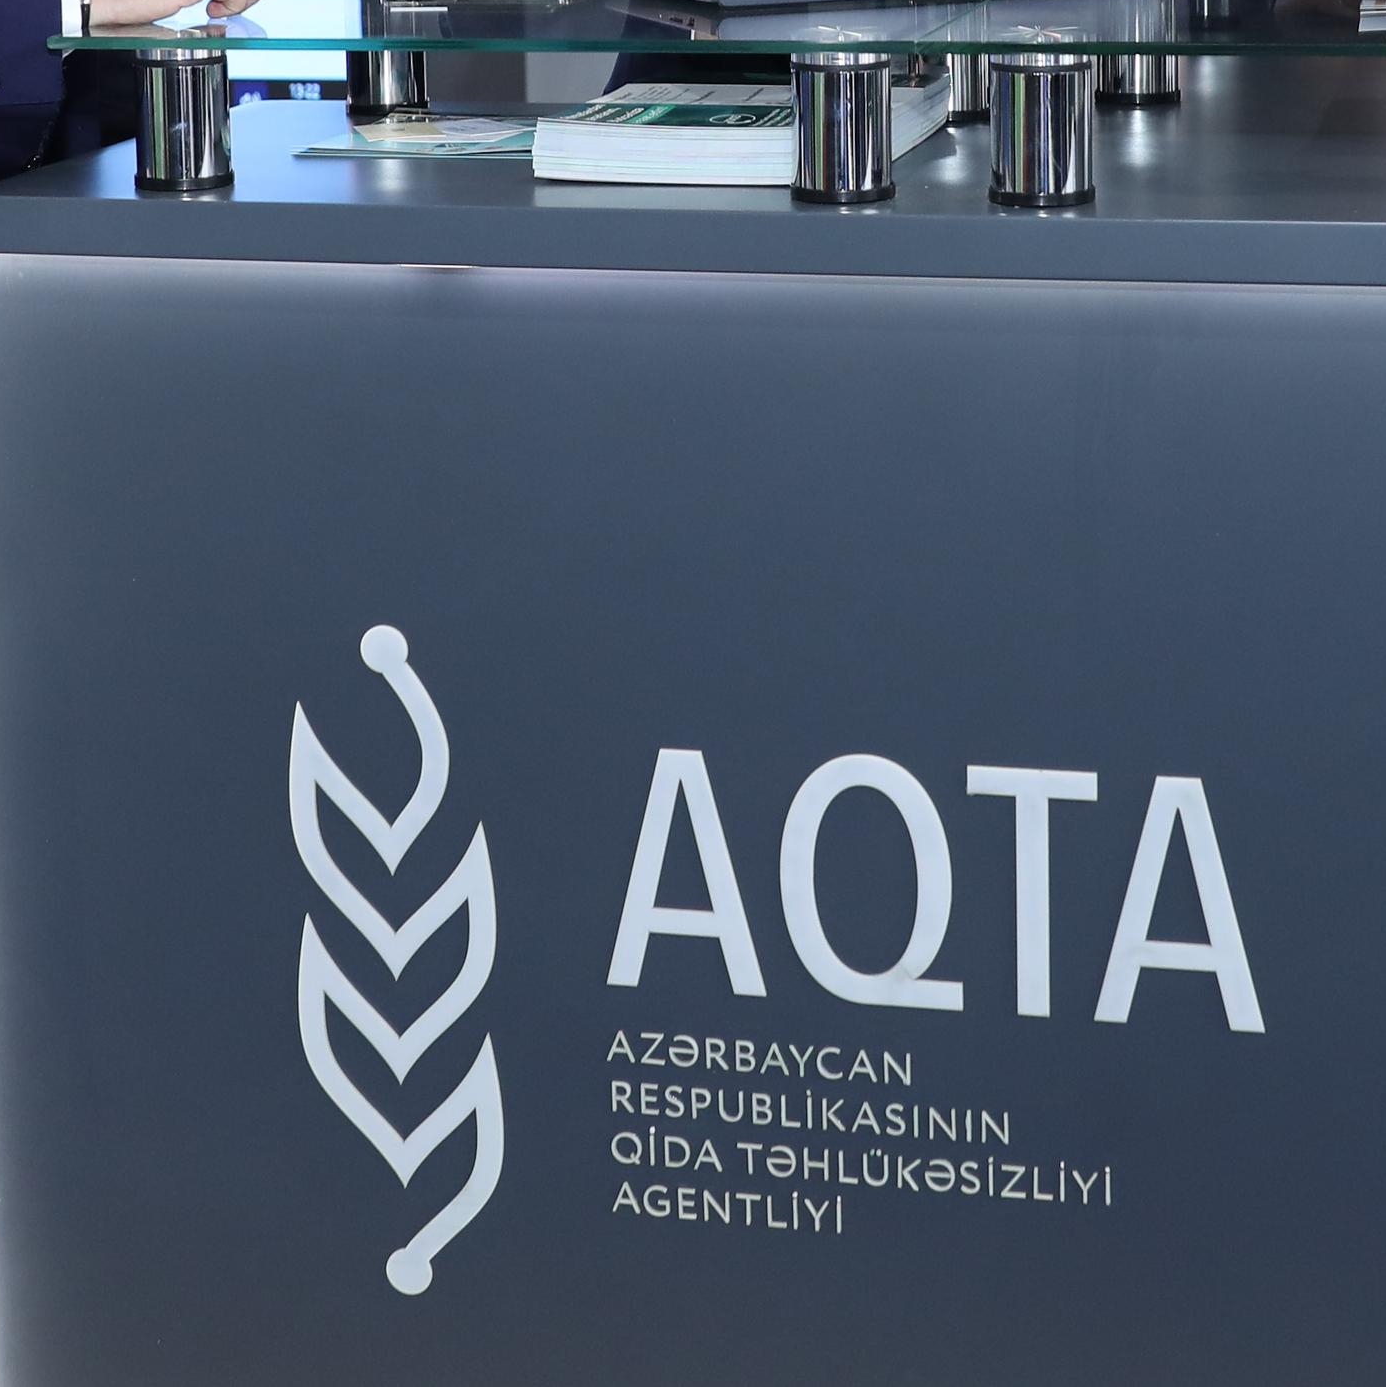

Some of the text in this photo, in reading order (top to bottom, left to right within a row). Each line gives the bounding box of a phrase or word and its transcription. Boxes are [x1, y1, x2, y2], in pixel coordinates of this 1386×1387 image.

[606, 747, 1266, 1034] AQTA
[606, 1029, 911, 1086] AZƏRBAYCAN
[610, 1080, 1010, 1145] RESPUBLİKASININ
[610, 1126, 1111, 1206] QİDA TƏHLÜKƏSİZLİYİ
[612, 1181, 843, 1234] AGENTLİYİ
